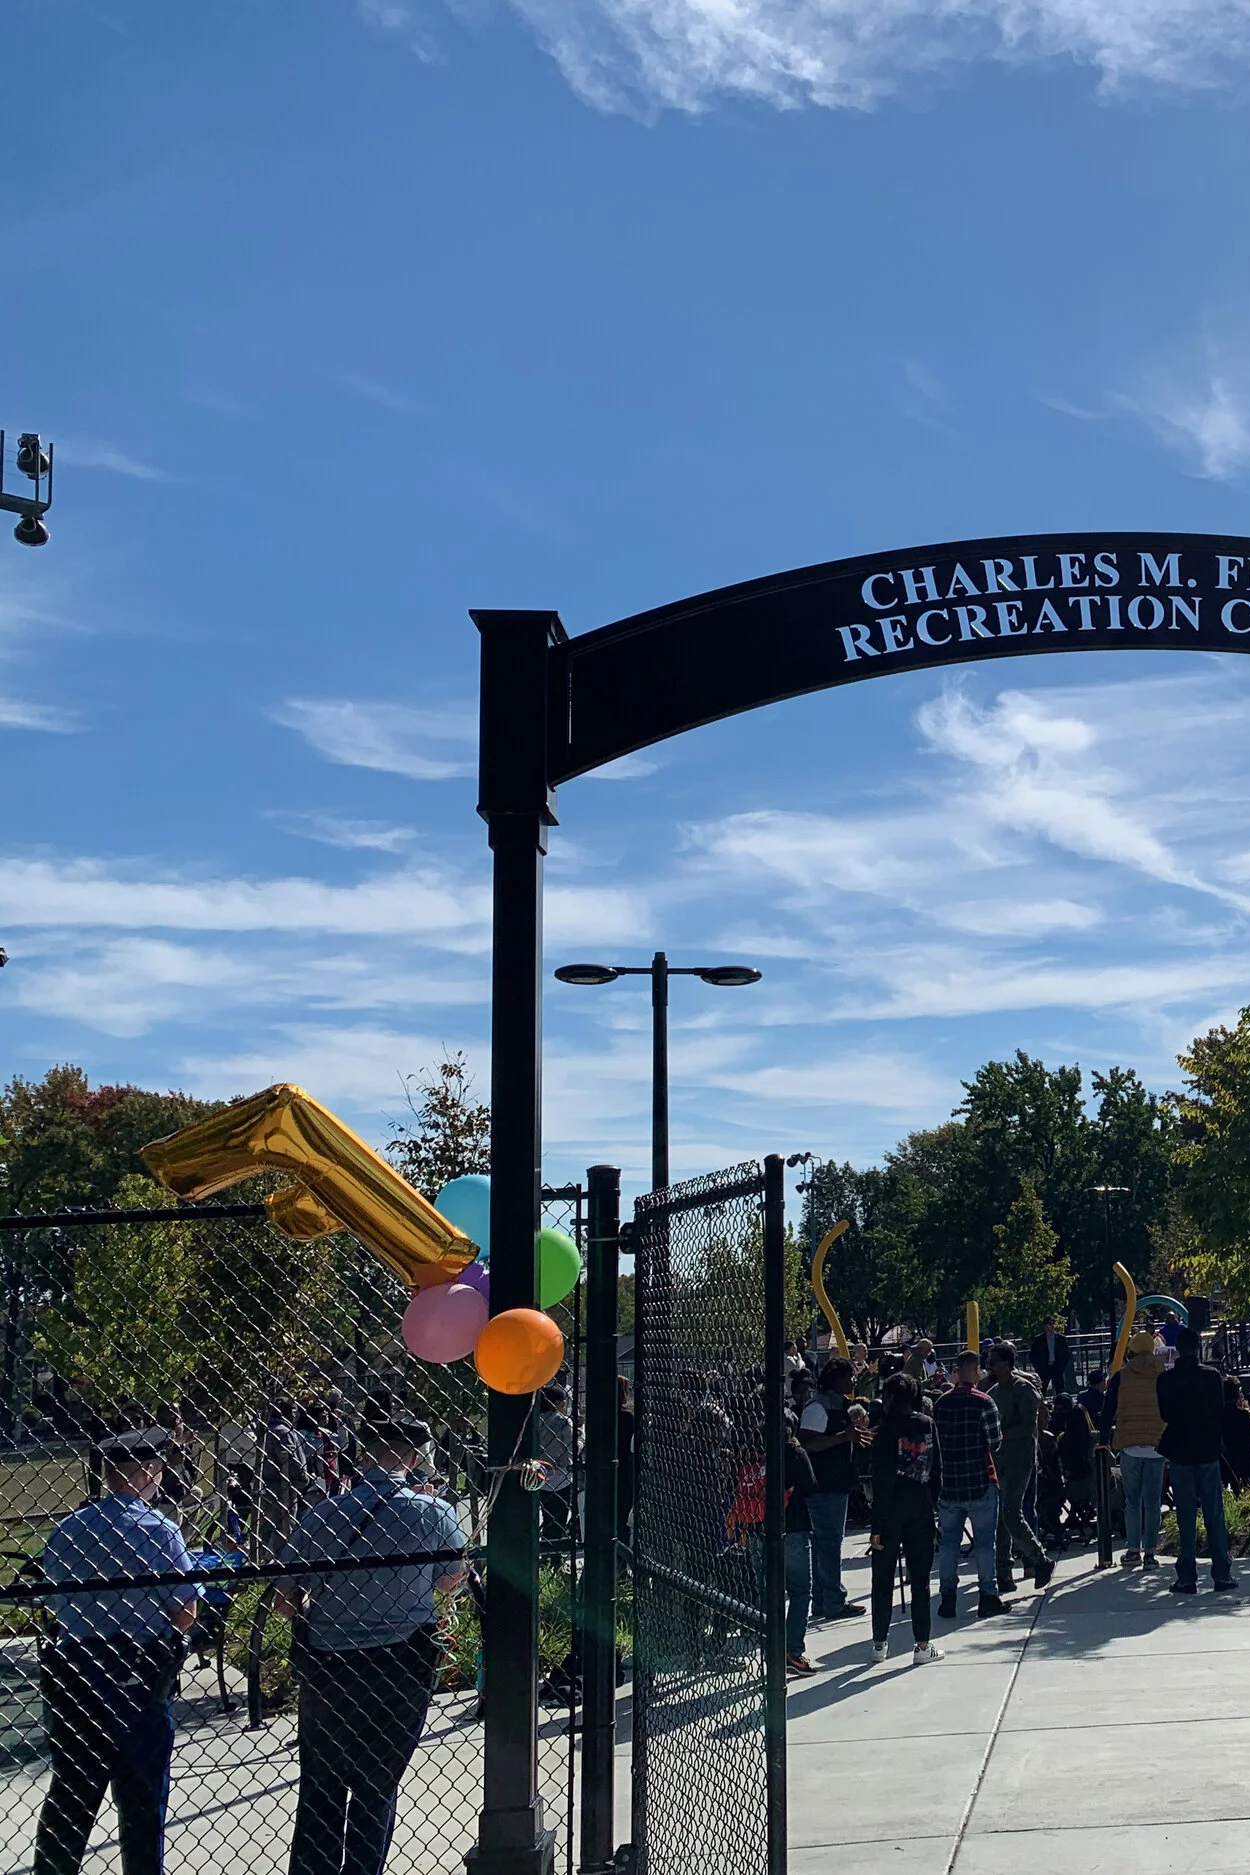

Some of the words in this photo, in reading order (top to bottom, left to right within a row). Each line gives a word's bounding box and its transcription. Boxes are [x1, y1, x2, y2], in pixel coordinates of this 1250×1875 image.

[862, 553, 1119, 609] CHARLES
[1137, 553, 1198, 588] M.
[836, 596, 1202, 661] RECREATION
